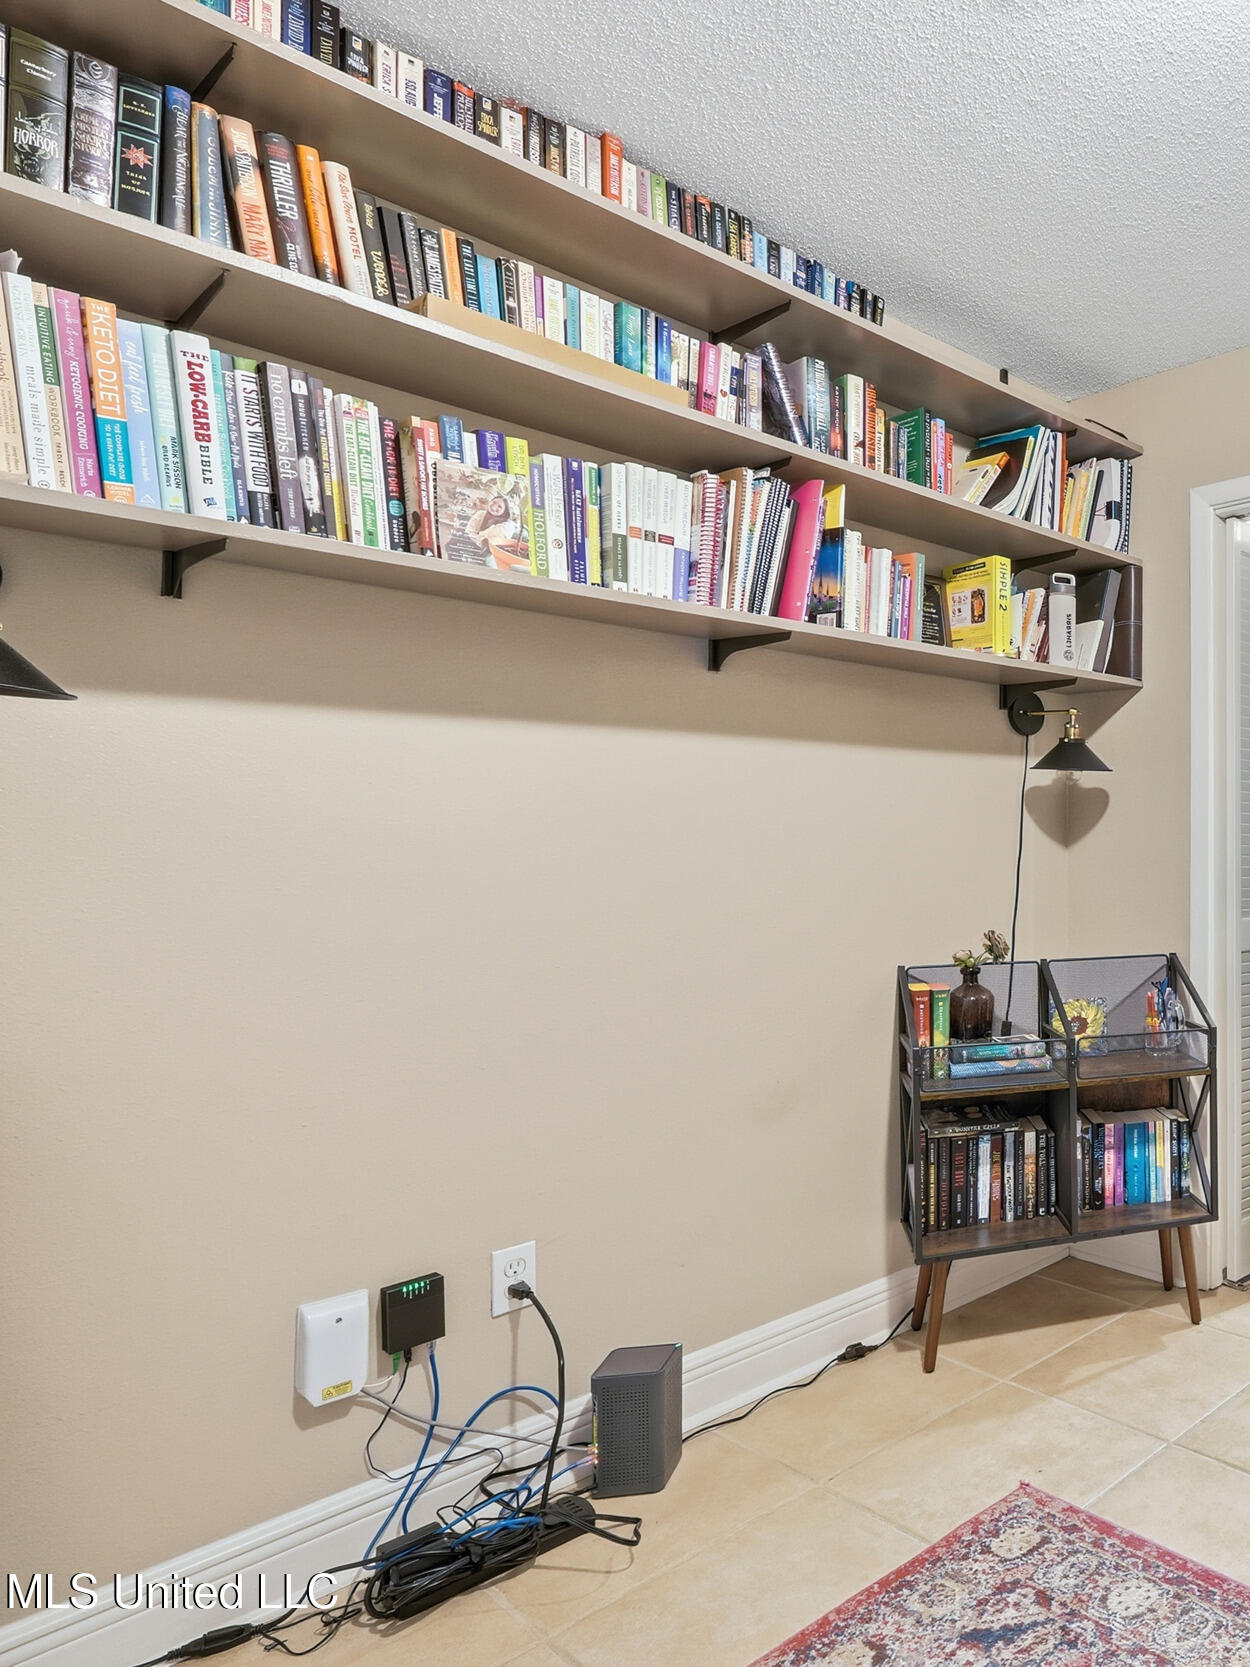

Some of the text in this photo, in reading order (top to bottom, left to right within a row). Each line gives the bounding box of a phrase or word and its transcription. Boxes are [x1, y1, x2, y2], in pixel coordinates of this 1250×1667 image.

[13, 126, 59, 159] HORROR
[269, 159, 299, 221] THRILLER
[348, 226, 362, 260] MOTEL
[37, 307, 55, 383] INTUITIVE EATING
[91, 312, 121, 416] KETO DIET
[70, 359, 89, 450] KETOGENIC COOKING
[243, 387, 263, 427] STARTS
[270, 373, 297, 480] no crumbs left
[198, 445, 214, 486] BIBLE
[248, 431, 267, 458] WITH
[172, 461, 183, 489] SISSON
[251, 459, 269, 487] FOOD
[533, 511, 546, 569] HOLFORD
[999, 561, 1008, 612] SIMPLE 2
